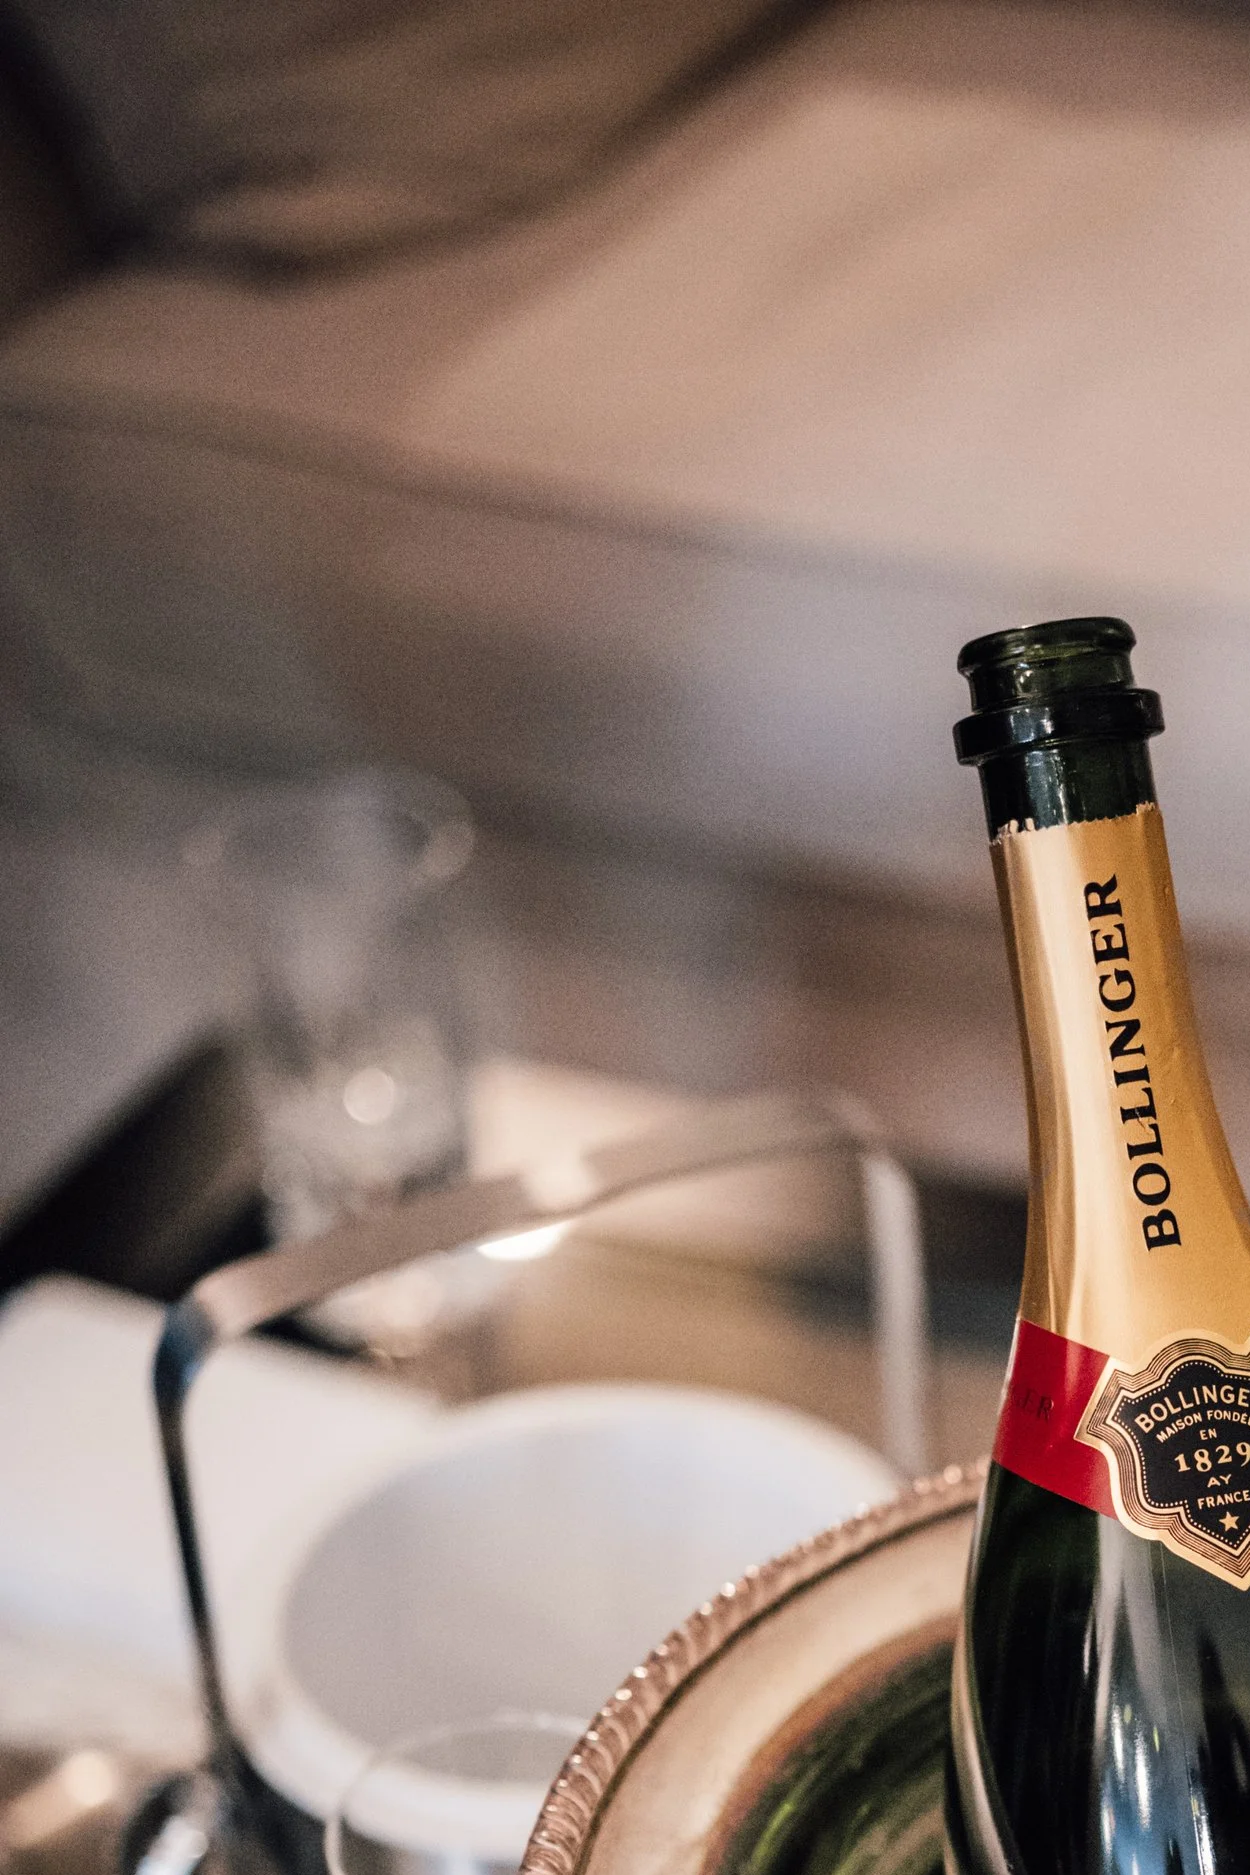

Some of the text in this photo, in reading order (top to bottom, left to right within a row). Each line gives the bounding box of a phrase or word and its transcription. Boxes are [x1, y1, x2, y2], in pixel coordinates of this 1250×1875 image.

[1084, 872, 1182, 1252] BOLLINGER
[1156, 1412, 1202, 1444] MAISON
[1199, 1428, 1218, 1441] EN
[1207, 1474, 1232, 1488] AY
